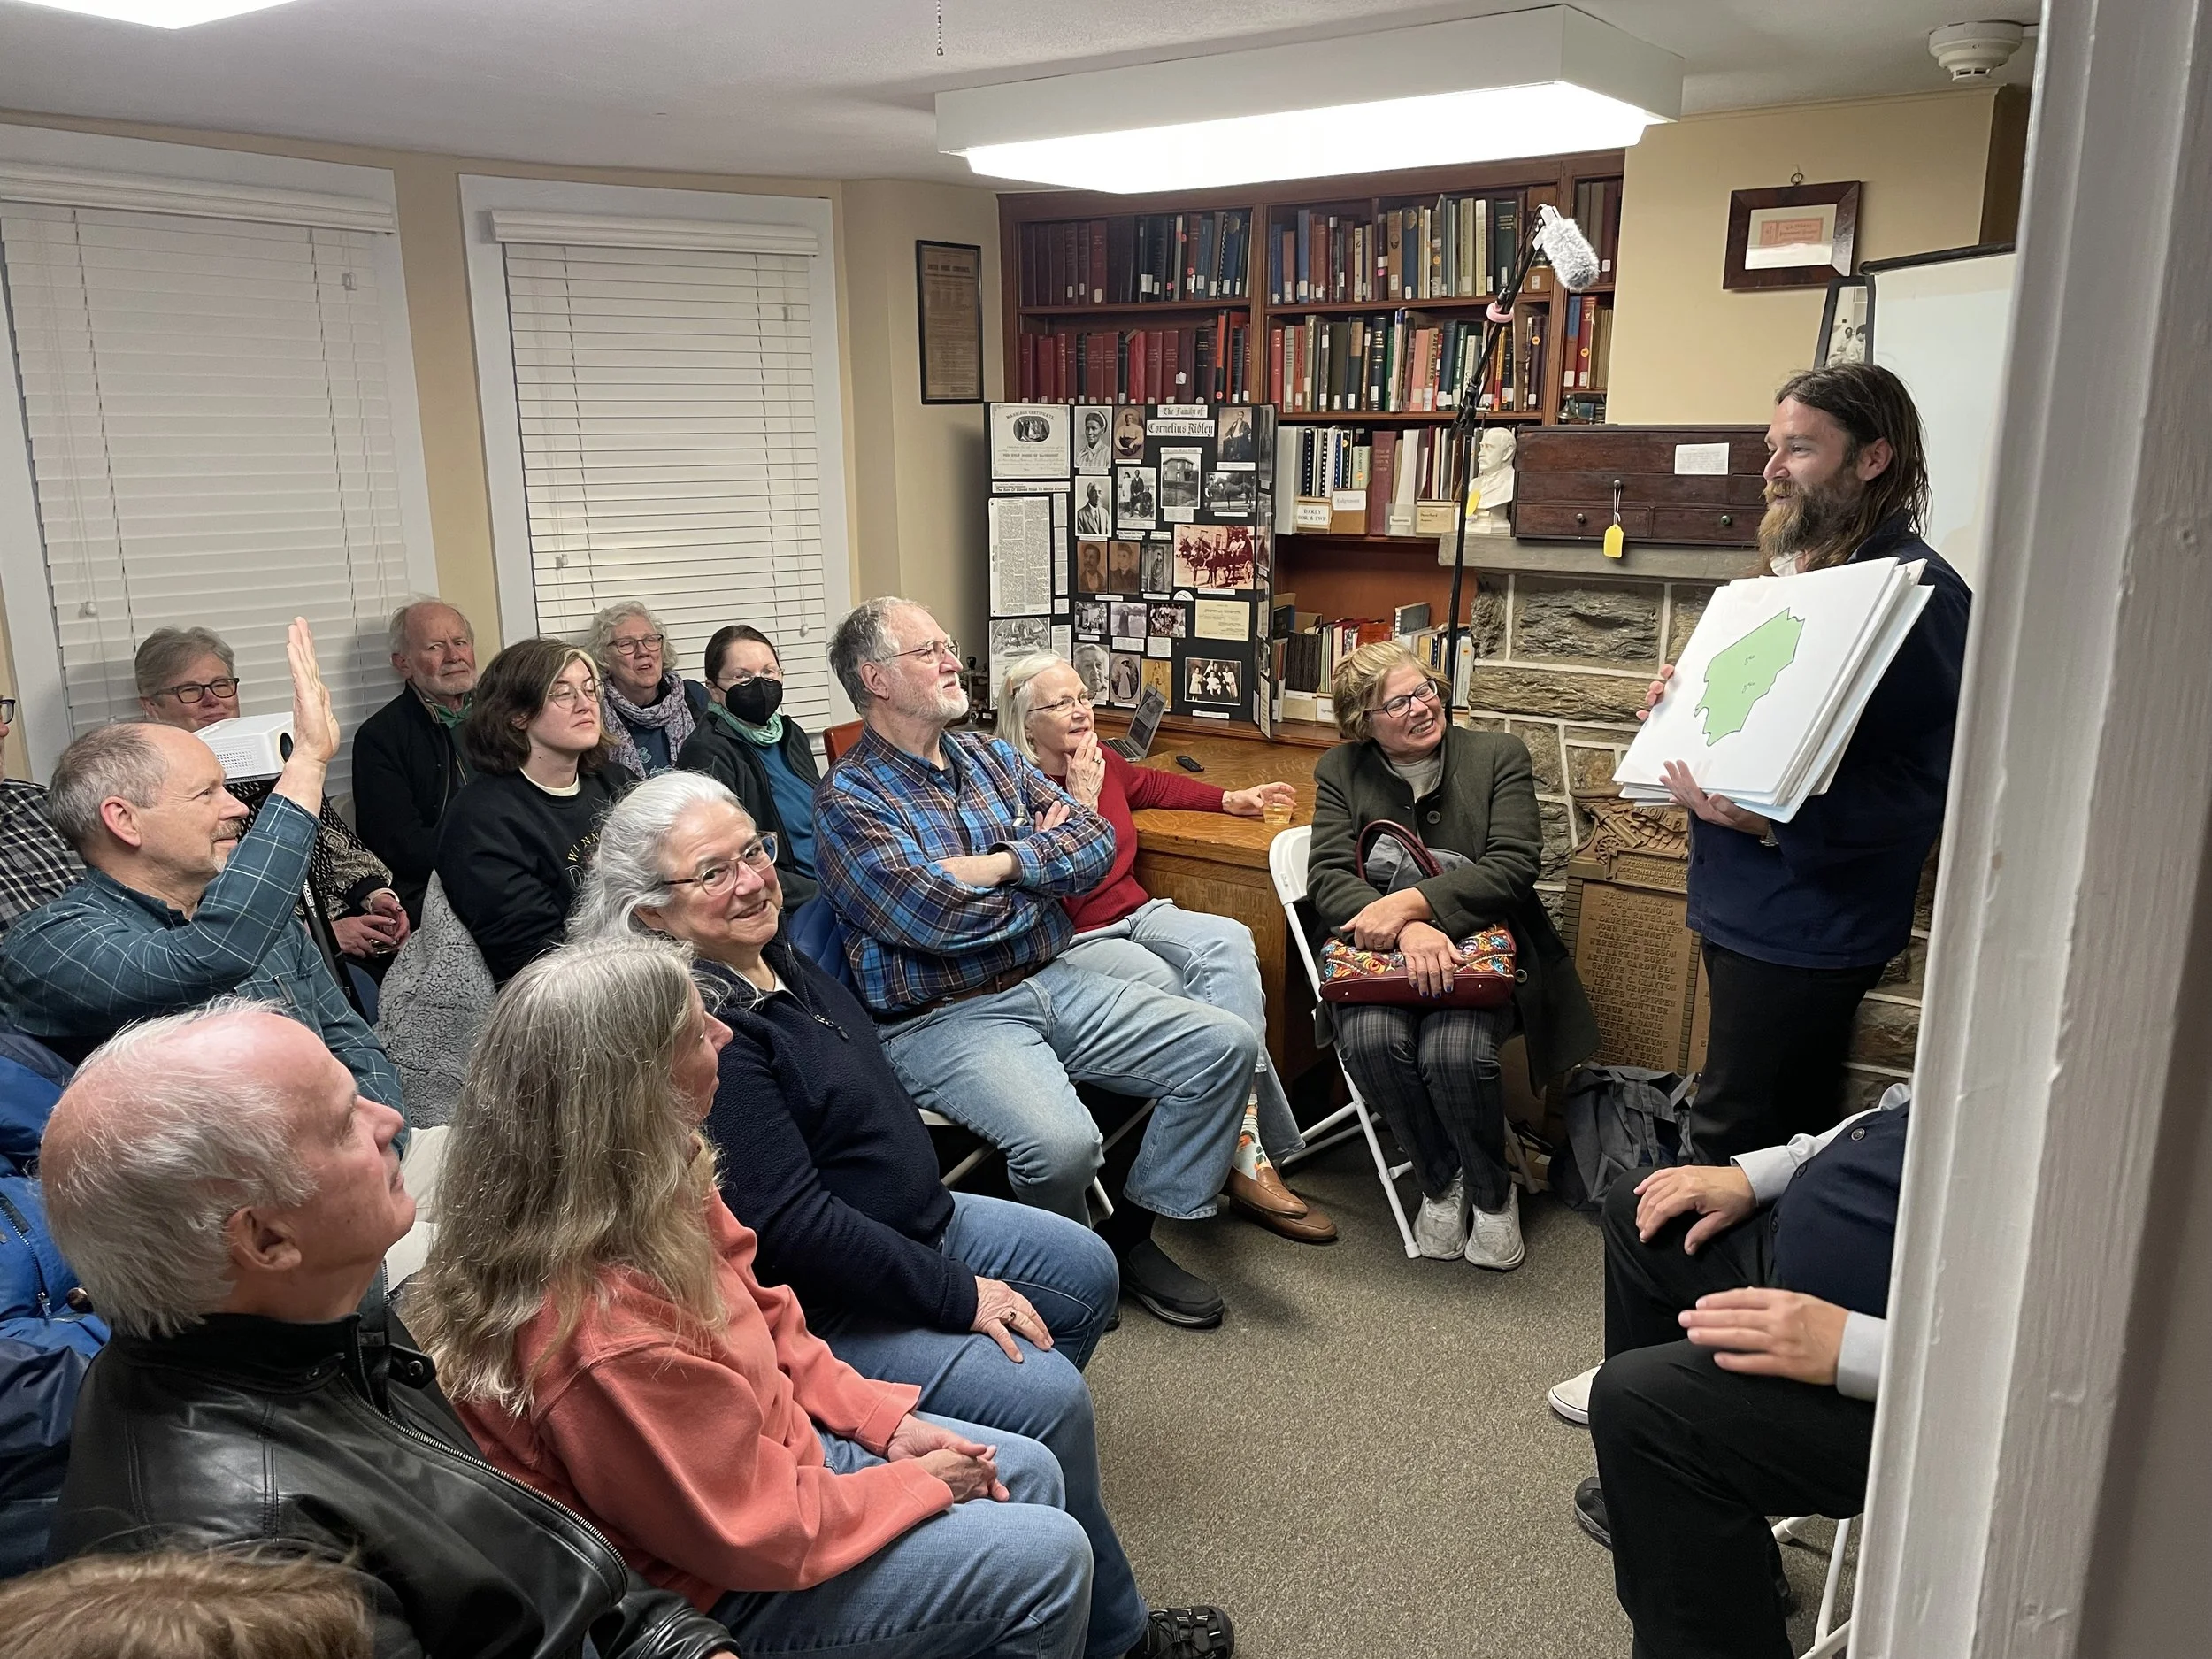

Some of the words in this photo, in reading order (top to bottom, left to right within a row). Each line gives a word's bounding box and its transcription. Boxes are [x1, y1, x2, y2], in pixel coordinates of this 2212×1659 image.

[1006, 410, 1028, 419] MARRIAGE
[1029, 410, 1055, 420] CERTIFICATE
[1176, 407, 1196, 418] Family
[1148, 422, 1187, 434] Cornelius
[1187, 422, 1213, 437] Ridley
[568, 832, 600, 862] WINN
[1649, 876, 1668, 885] NEED
[1657, 871, 1677, 879] DAILY
[1603, 891, 1628, 902] FRED
[1610, 908, 1619, 917] C.
[1617, 901, 1625, 910] C.
[1638, 905, 1674, 917] ARNOLD
[1595, 922, 1618, 932] JOHN
[1632, 929, 1674, 941] BENNETT
[1599, 915, 1643, 928] LAURENCE
[1647, 922, 1684, 934] BAXTER
[1589, 938, 1631, 951] HERBERT
[1644, 947, 1678, 958] BEESON
[1598, 931, 1639, 944] CHARLES
[1643, 938, 1671, 949] BLAIR
[1606, 949, 1640, 960] LARKIN
[1586, 953, 1623, 965] ARTHUR
[1627, 960, 1677, 974] CARDWELL
[1592, 961, 1625, 973] GEORGE
[1640, 970, 1671, 982] CLARK
[1584, 969, 1623, 982] WILLIAM
[1638, 978, 1677, 991] CLAYTON
[1594, 978, 1611, 987] LEE
[1625, 983, 1663, 996] CRIPPEN
[1620, 999, 1669, 1015] CROWTHER
[1640, 995, 1677, 1007] CRIPPEN
[1594, 1002, 1624, 1015] RTHUR
[1639, 1011, 1664, 1023] DAVIS
[1594, 1010, 1624, 1023] DWARD
[1638, 1019, 1663, 1031] DAVIS
[1594, 1018, 1631, 1033] RIFFITH
[1635, 1026, 1661, 1038] DAVIS
[1602, 1036, 1619, 1046] OHN
[1628, 1033, 1669, 1048] DEAKYNE
[1629, 1049, 1638, 1058] L.
